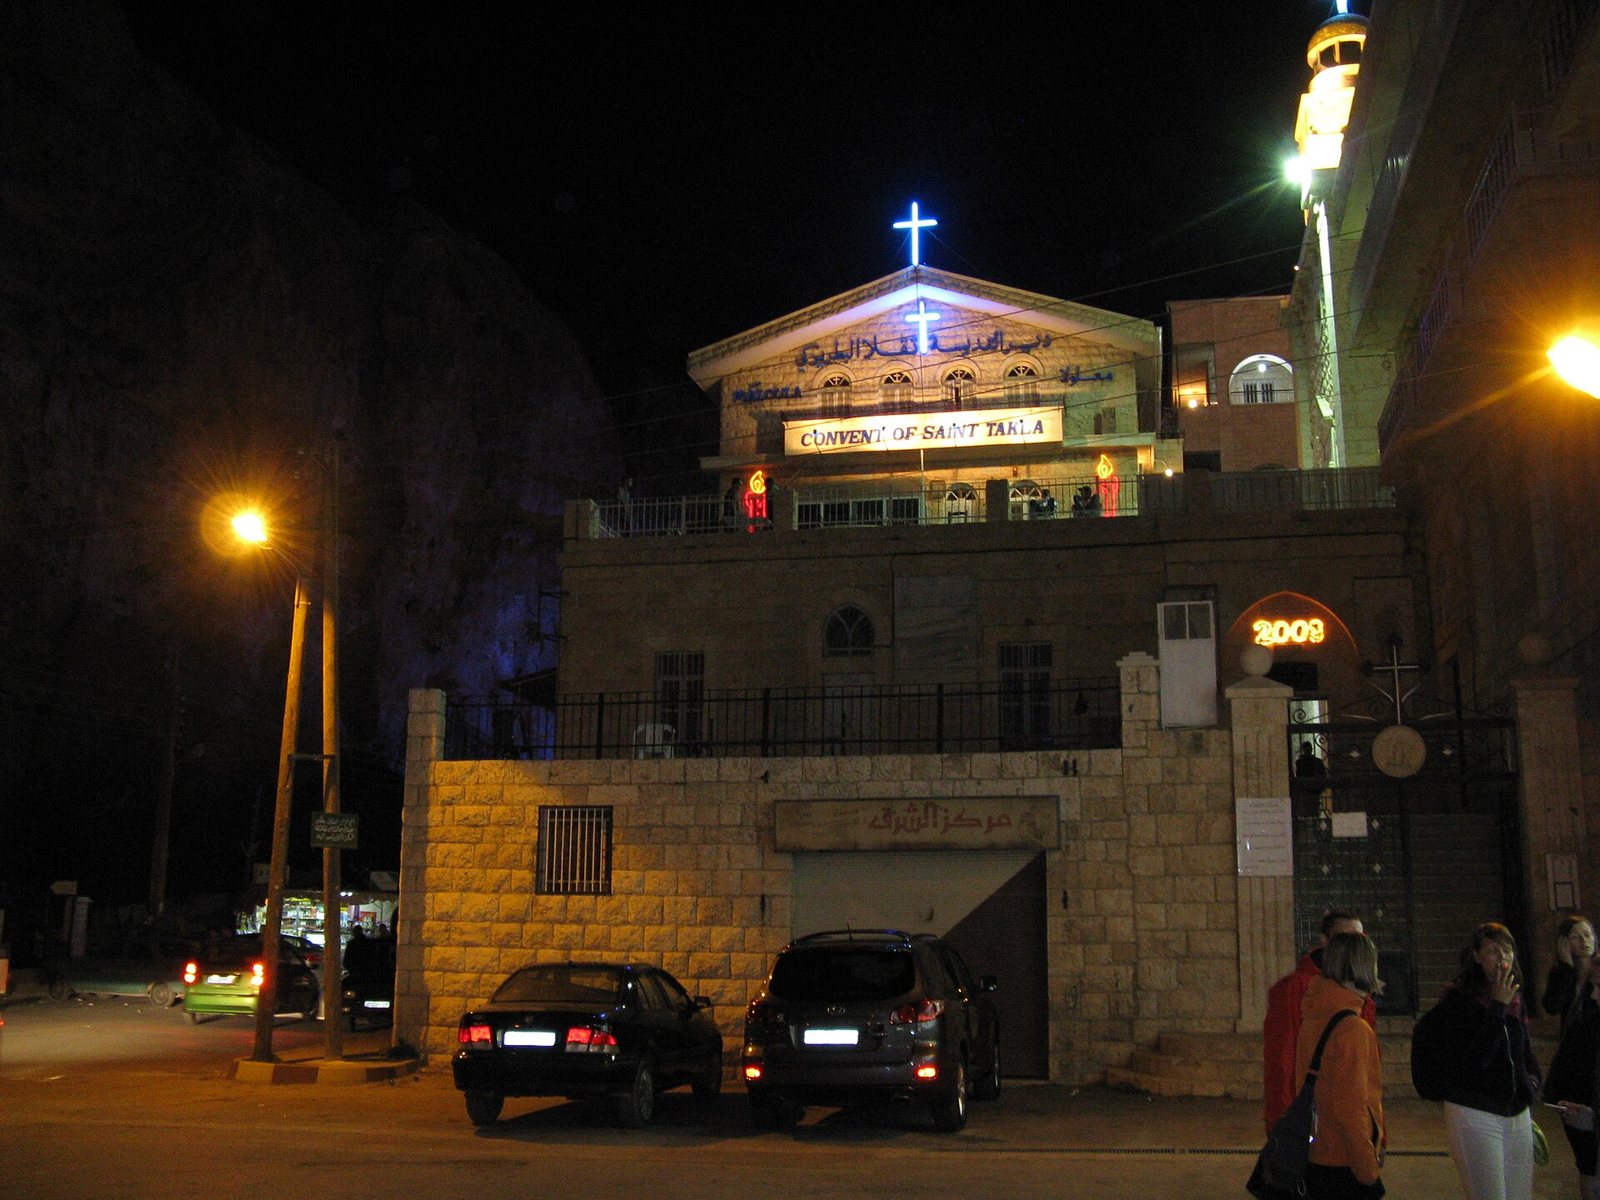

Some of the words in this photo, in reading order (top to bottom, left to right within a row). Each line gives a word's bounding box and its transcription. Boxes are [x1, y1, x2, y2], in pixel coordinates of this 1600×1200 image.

[800, 429, 883, 447] CONVENT
[893, 426, 918, 441] OF
[922, 423, 979, 440] SAINT
[986, 419, 1044, 437] TAKLA
[869, 801, 939, 835] الشرق
[941, 806, 1012, 835] مركز
